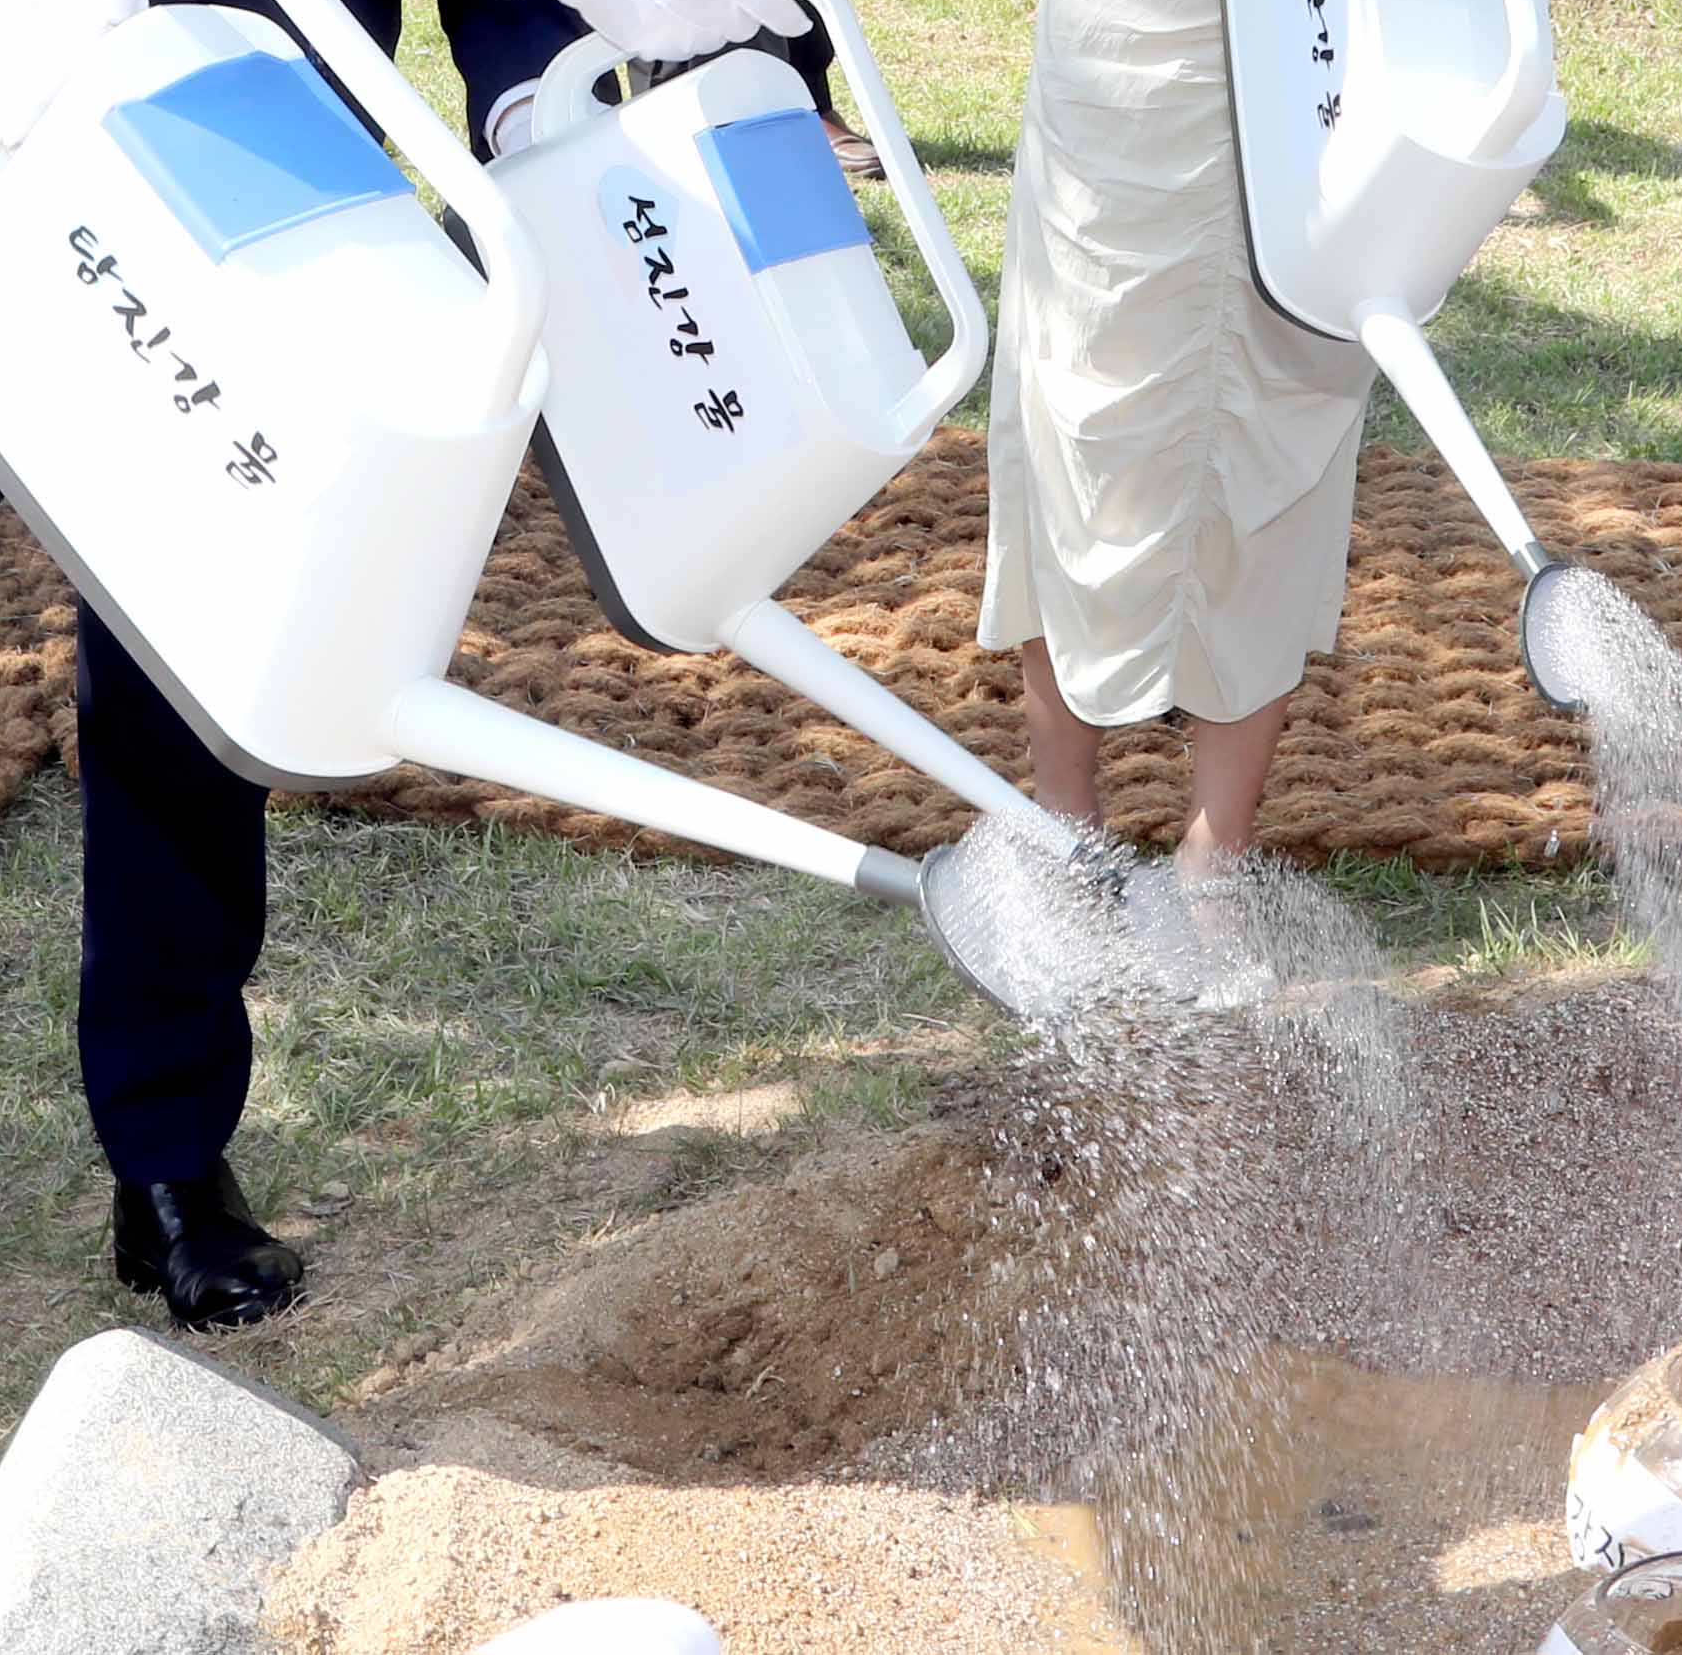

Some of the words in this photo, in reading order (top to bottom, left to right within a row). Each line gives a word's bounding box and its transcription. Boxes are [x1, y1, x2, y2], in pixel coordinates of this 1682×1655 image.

[1317, 91, 1342, 130] 물
[622, 195, 715, 365] 섬진강
[693, 388, 744, 434] 물
[225, 431, 278, 490] 물
